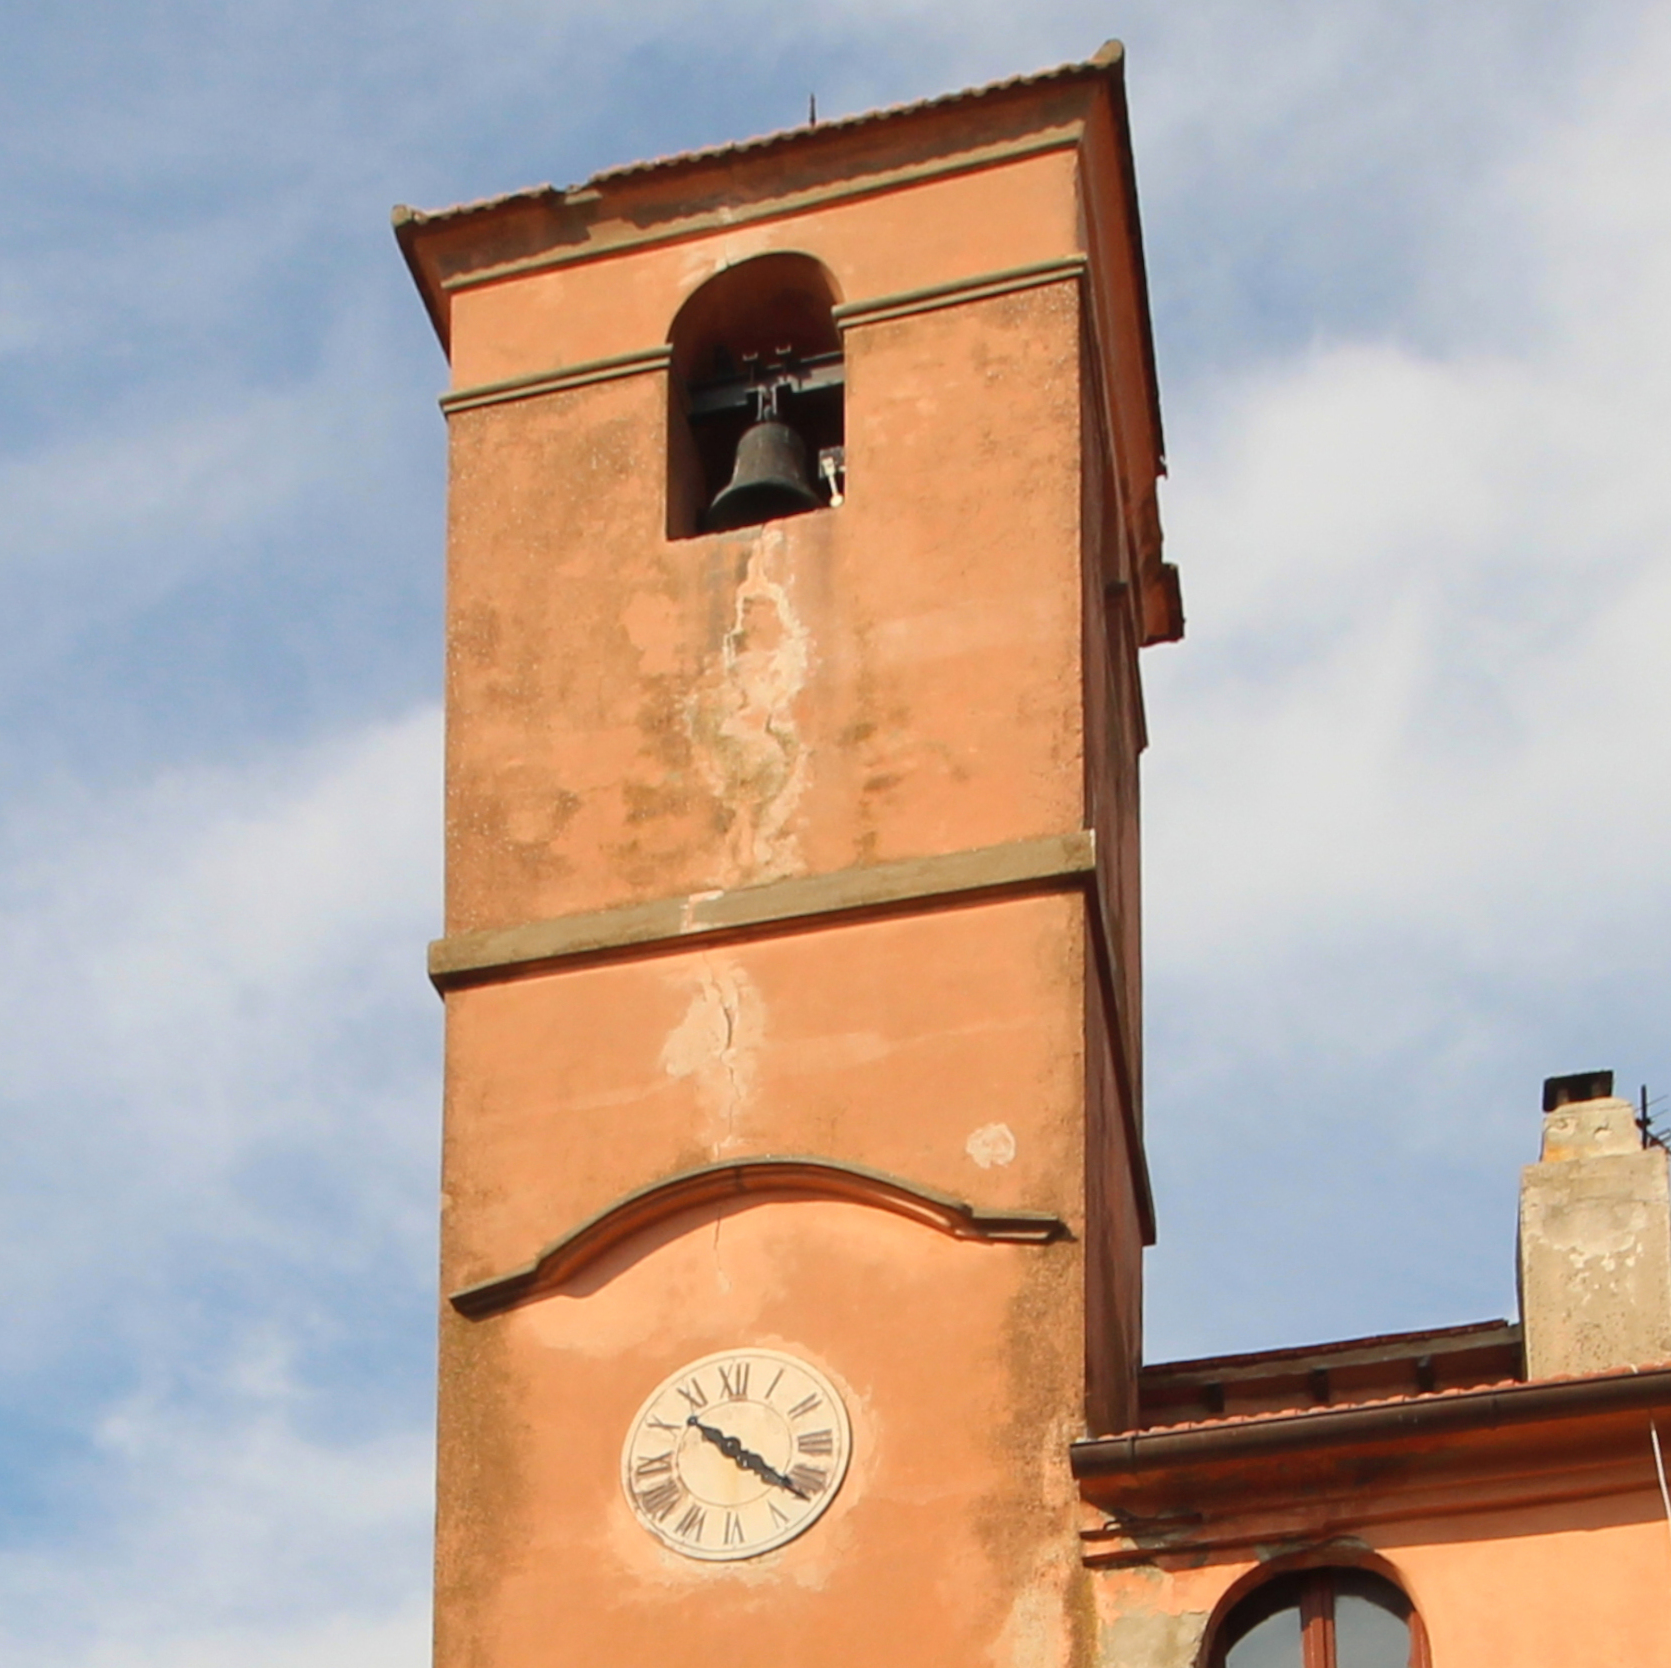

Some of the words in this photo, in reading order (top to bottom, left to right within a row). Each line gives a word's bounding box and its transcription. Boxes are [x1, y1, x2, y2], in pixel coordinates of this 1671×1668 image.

[676, 1377, 709, 1408] XI
[718, 1363, 750, 1401] XII
[764, 1368, 785, 1400] I
[787, 1391, 823, 1421] II
[723, 1511, 745, 1545] VI
